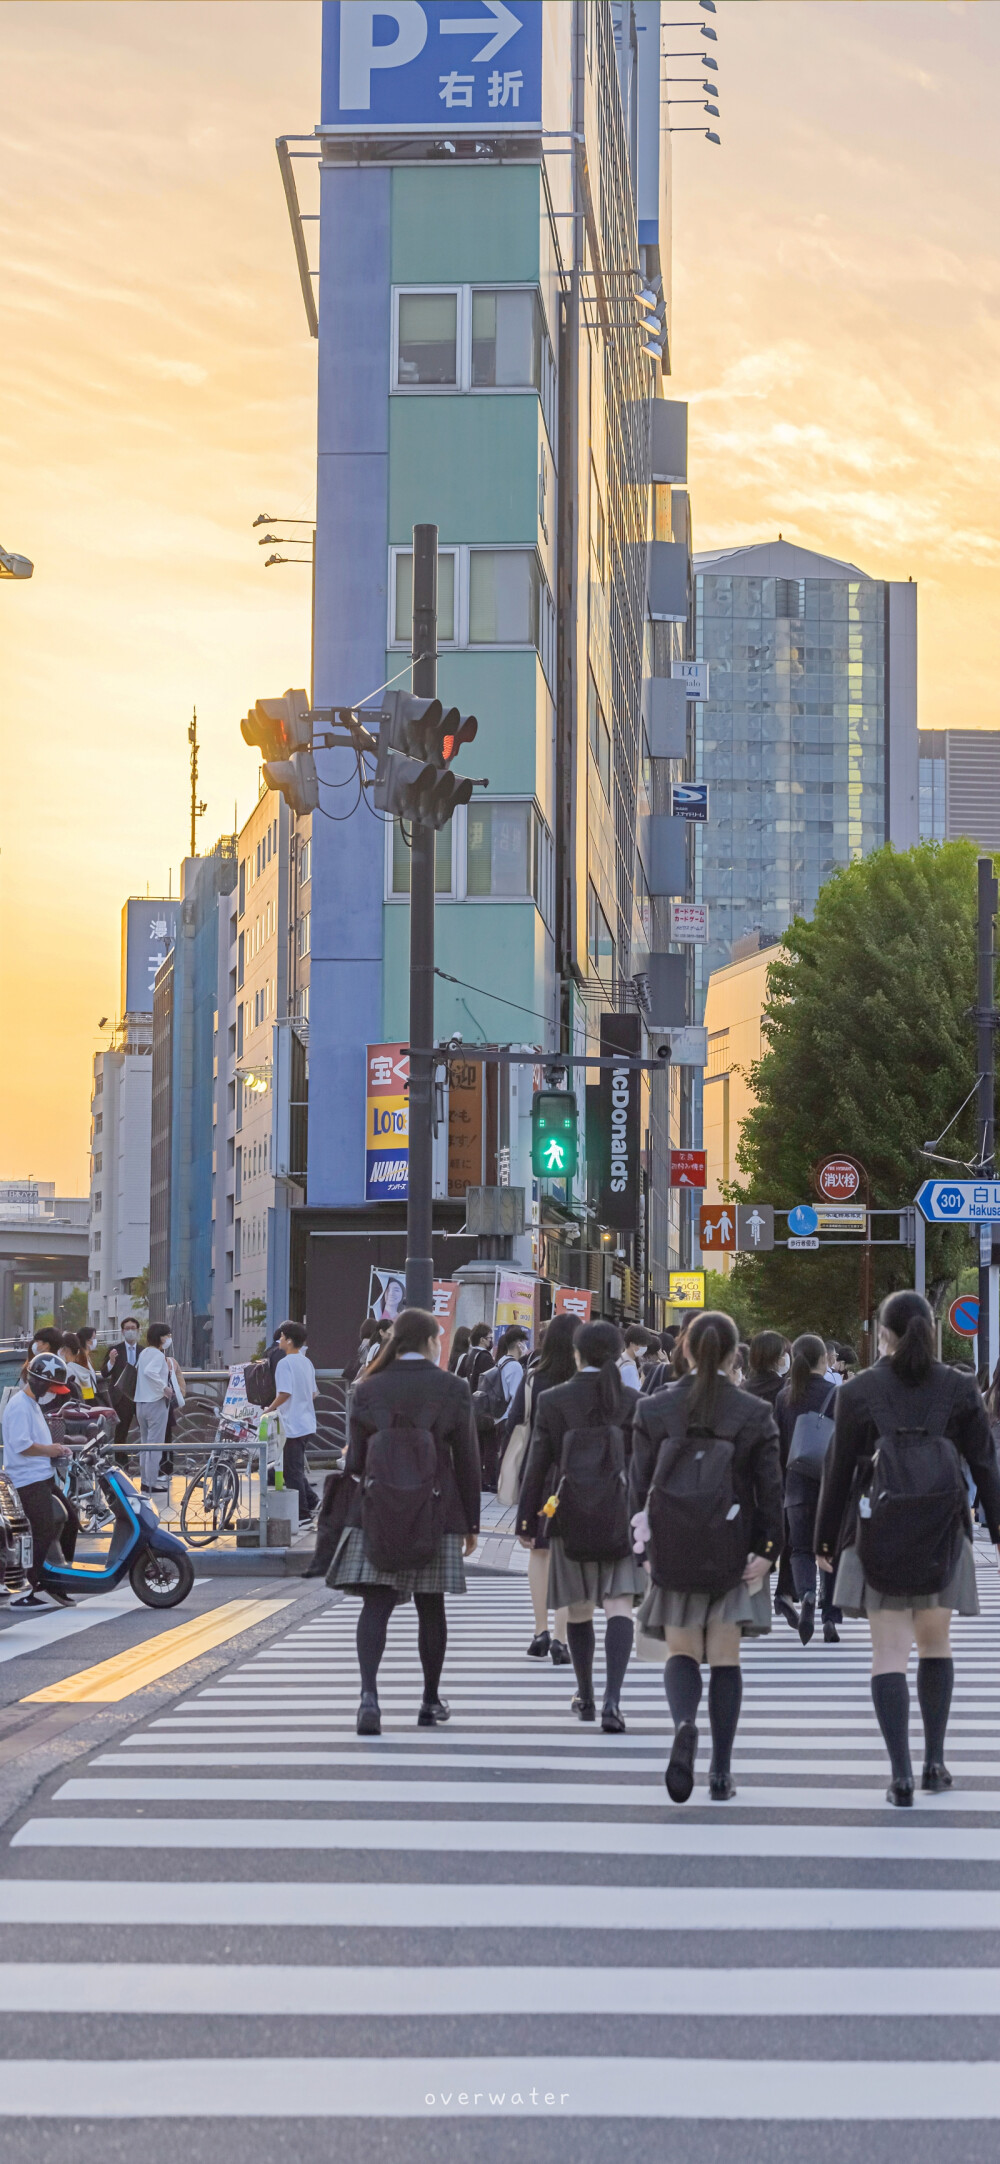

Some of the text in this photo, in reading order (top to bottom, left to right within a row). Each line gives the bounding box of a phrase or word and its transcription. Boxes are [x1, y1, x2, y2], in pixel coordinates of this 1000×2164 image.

[338, 1, 428, 110] P
[438, 69, 524, 108] 右折
[674, 908, 704, 916] ボードゲーム
[373, 1107, 404, 1136] LOTO
[610, 1053, 630, 1193] McDonald's
[824, 1172, 856, 1188] 消火栓
[941, 1194, 961, 1208] 301
